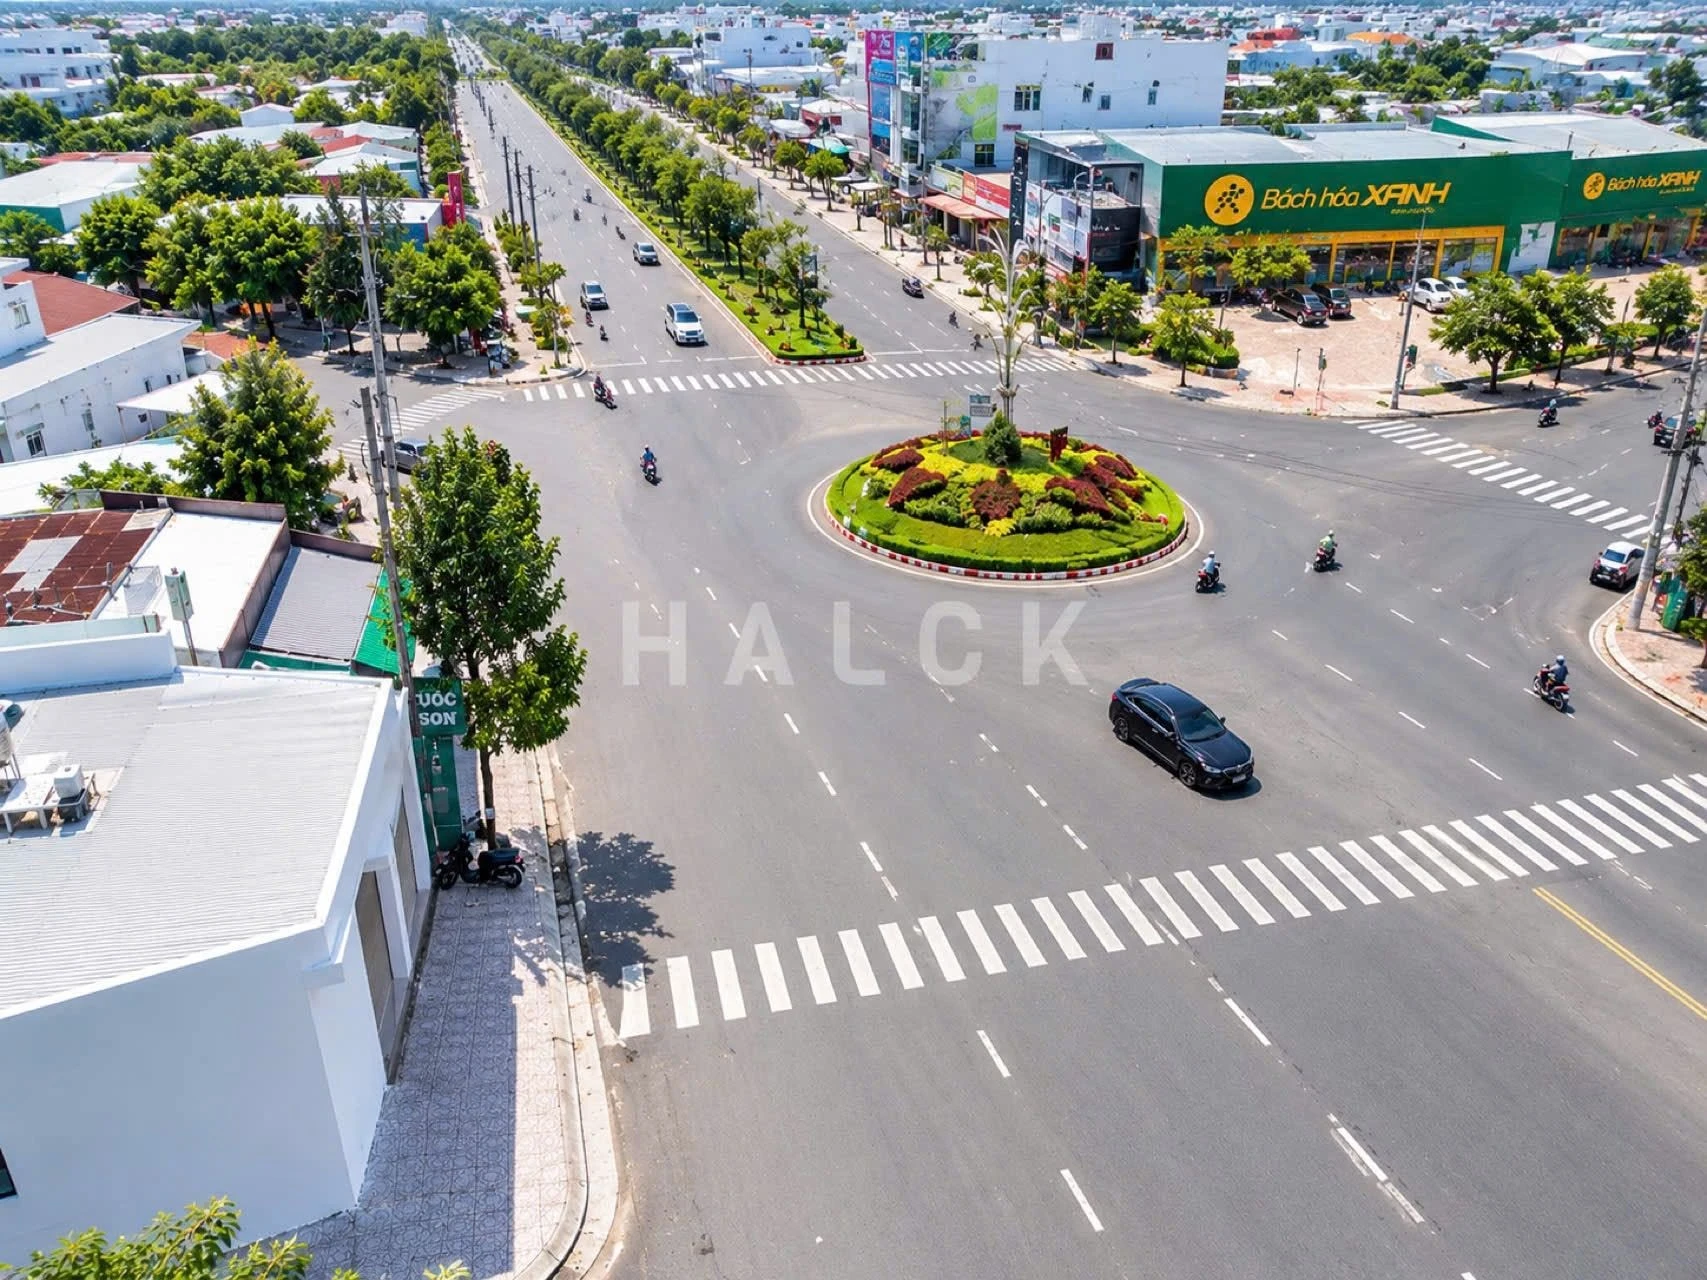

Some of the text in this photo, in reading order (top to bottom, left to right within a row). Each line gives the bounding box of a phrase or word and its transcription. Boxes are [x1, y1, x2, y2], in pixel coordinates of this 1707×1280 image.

[1607, 176, 1635, 191] Bách
[1657, 170, 1702, 187] XANH
[1260, 182, 1452, 210] Bách hóa XANH
